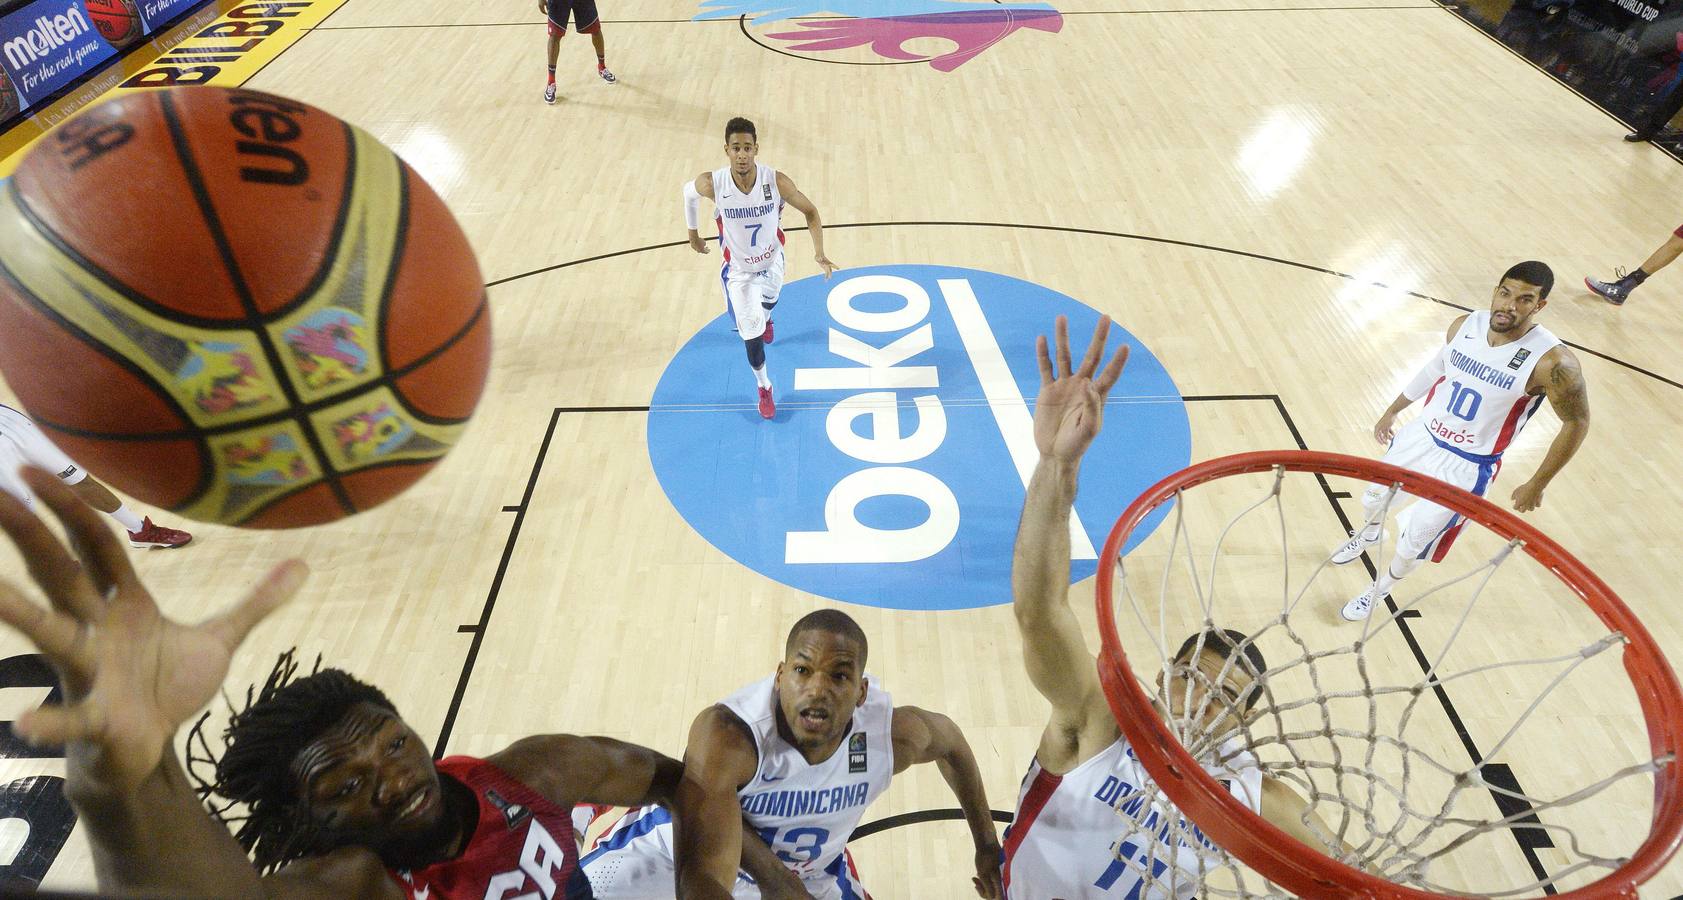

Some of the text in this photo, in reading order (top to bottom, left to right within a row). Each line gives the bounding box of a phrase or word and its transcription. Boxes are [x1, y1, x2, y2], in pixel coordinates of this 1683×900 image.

[145, 2, 157, 20] For
[1617, 0, 1659, 22] WORLD CUP
[4, 8, 89, 70] molten
[22, 40, 99, 93] For the real game
[724, 203, 775, 219] DOMINICANA
[744, 223, 762, 247] 7
[1449, 348, 1517, 390] DOMINICANA
[1446, 380, 1483, 421] 10
[784, 275, 960, 564] beko
[1430, 418, 1467, 443] Claro
[739, 782, 870, 818] DOMINICANA
